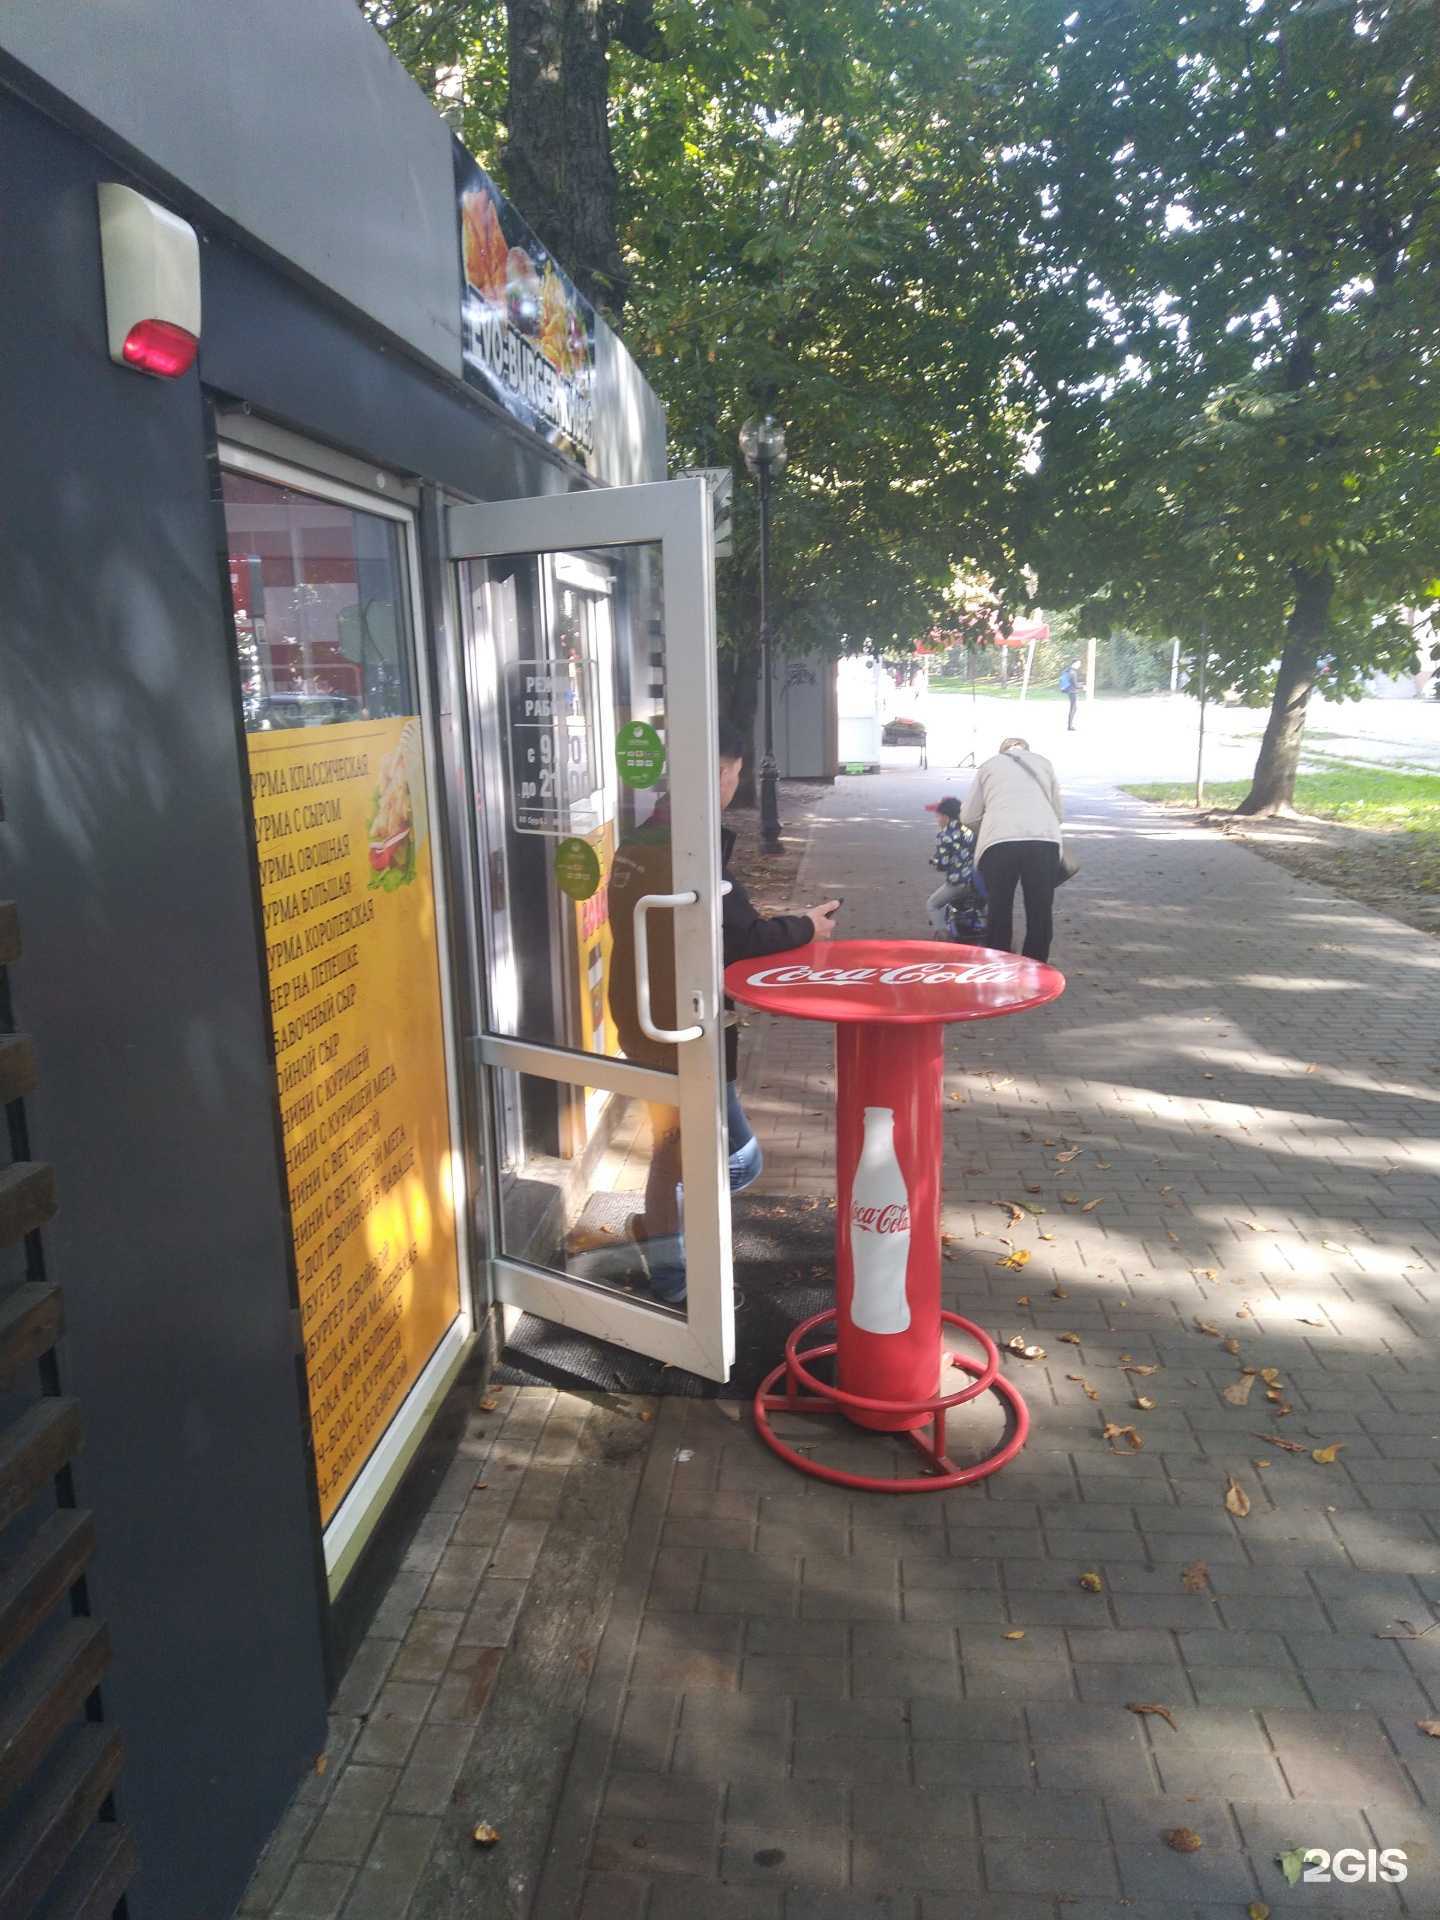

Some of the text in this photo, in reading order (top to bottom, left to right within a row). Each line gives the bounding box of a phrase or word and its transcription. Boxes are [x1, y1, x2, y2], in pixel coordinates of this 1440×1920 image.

[288, 754, 369, 790] КЛАССИЧЕСКАЯ
[521, 781, 537, 800] до
[293, 808, 302, 831] С
[301, 798, 342, 828] СЫРОМ
[296, 835, 350, 872] ОВОЩНАЯ
[300, 872, 352, 912] БОЛЬШАЯ
[304, 899, 374, 950] КОРОЛЕВСКАЯ
[292, 972, 309, 999] НА
[310, 944, 359, 988] ЛЕПЕШКЕ
[746, 962, 1021, 987] Coca-Cola
[335, 983, 356, 1013] СЫР
[317, 1032, 340, 1065] СЫР
[315, 1083, 324, 1107] С
[324, 1044, 370, 1100] КУРИЦЕЙ
[318, 1121, 327, 1145] С
[327, 1078, 373, 1137] КУРИЦЕЙ
[322, 1158, 331, 1182] С
[330, 1108, 381, 1173] ВЕТЧИНОЙ
[325, 1193, 334, 1219] С
